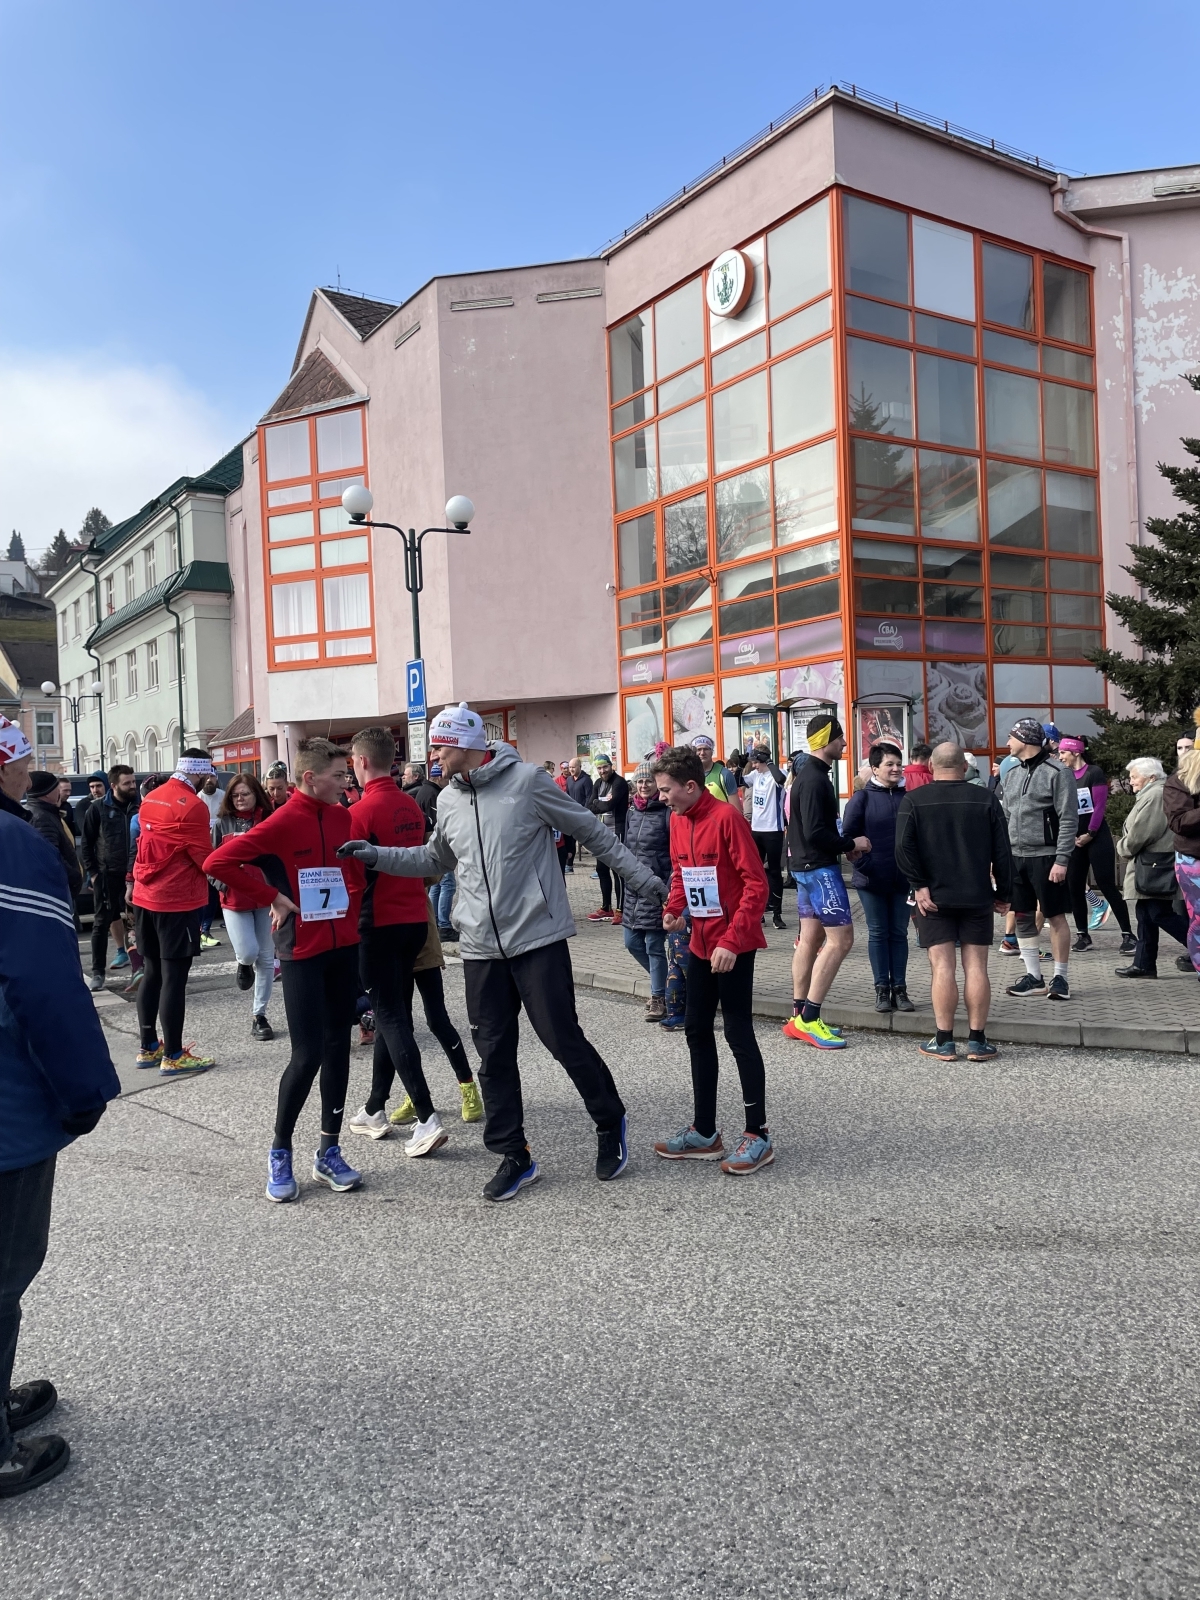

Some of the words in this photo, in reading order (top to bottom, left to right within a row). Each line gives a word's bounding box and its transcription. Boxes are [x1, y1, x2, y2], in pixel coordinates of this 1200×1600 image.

[881, 625, 895, 634] CBA
[741, 643, 752, 653] CBA
[409, 668, 420, 702] P
[438, 721, 452, 729] LES
[300, 870, 322, 878] ZIMNÍ
[319, 888, 331, 909] 7
[689, 887, 707, 907] 51
